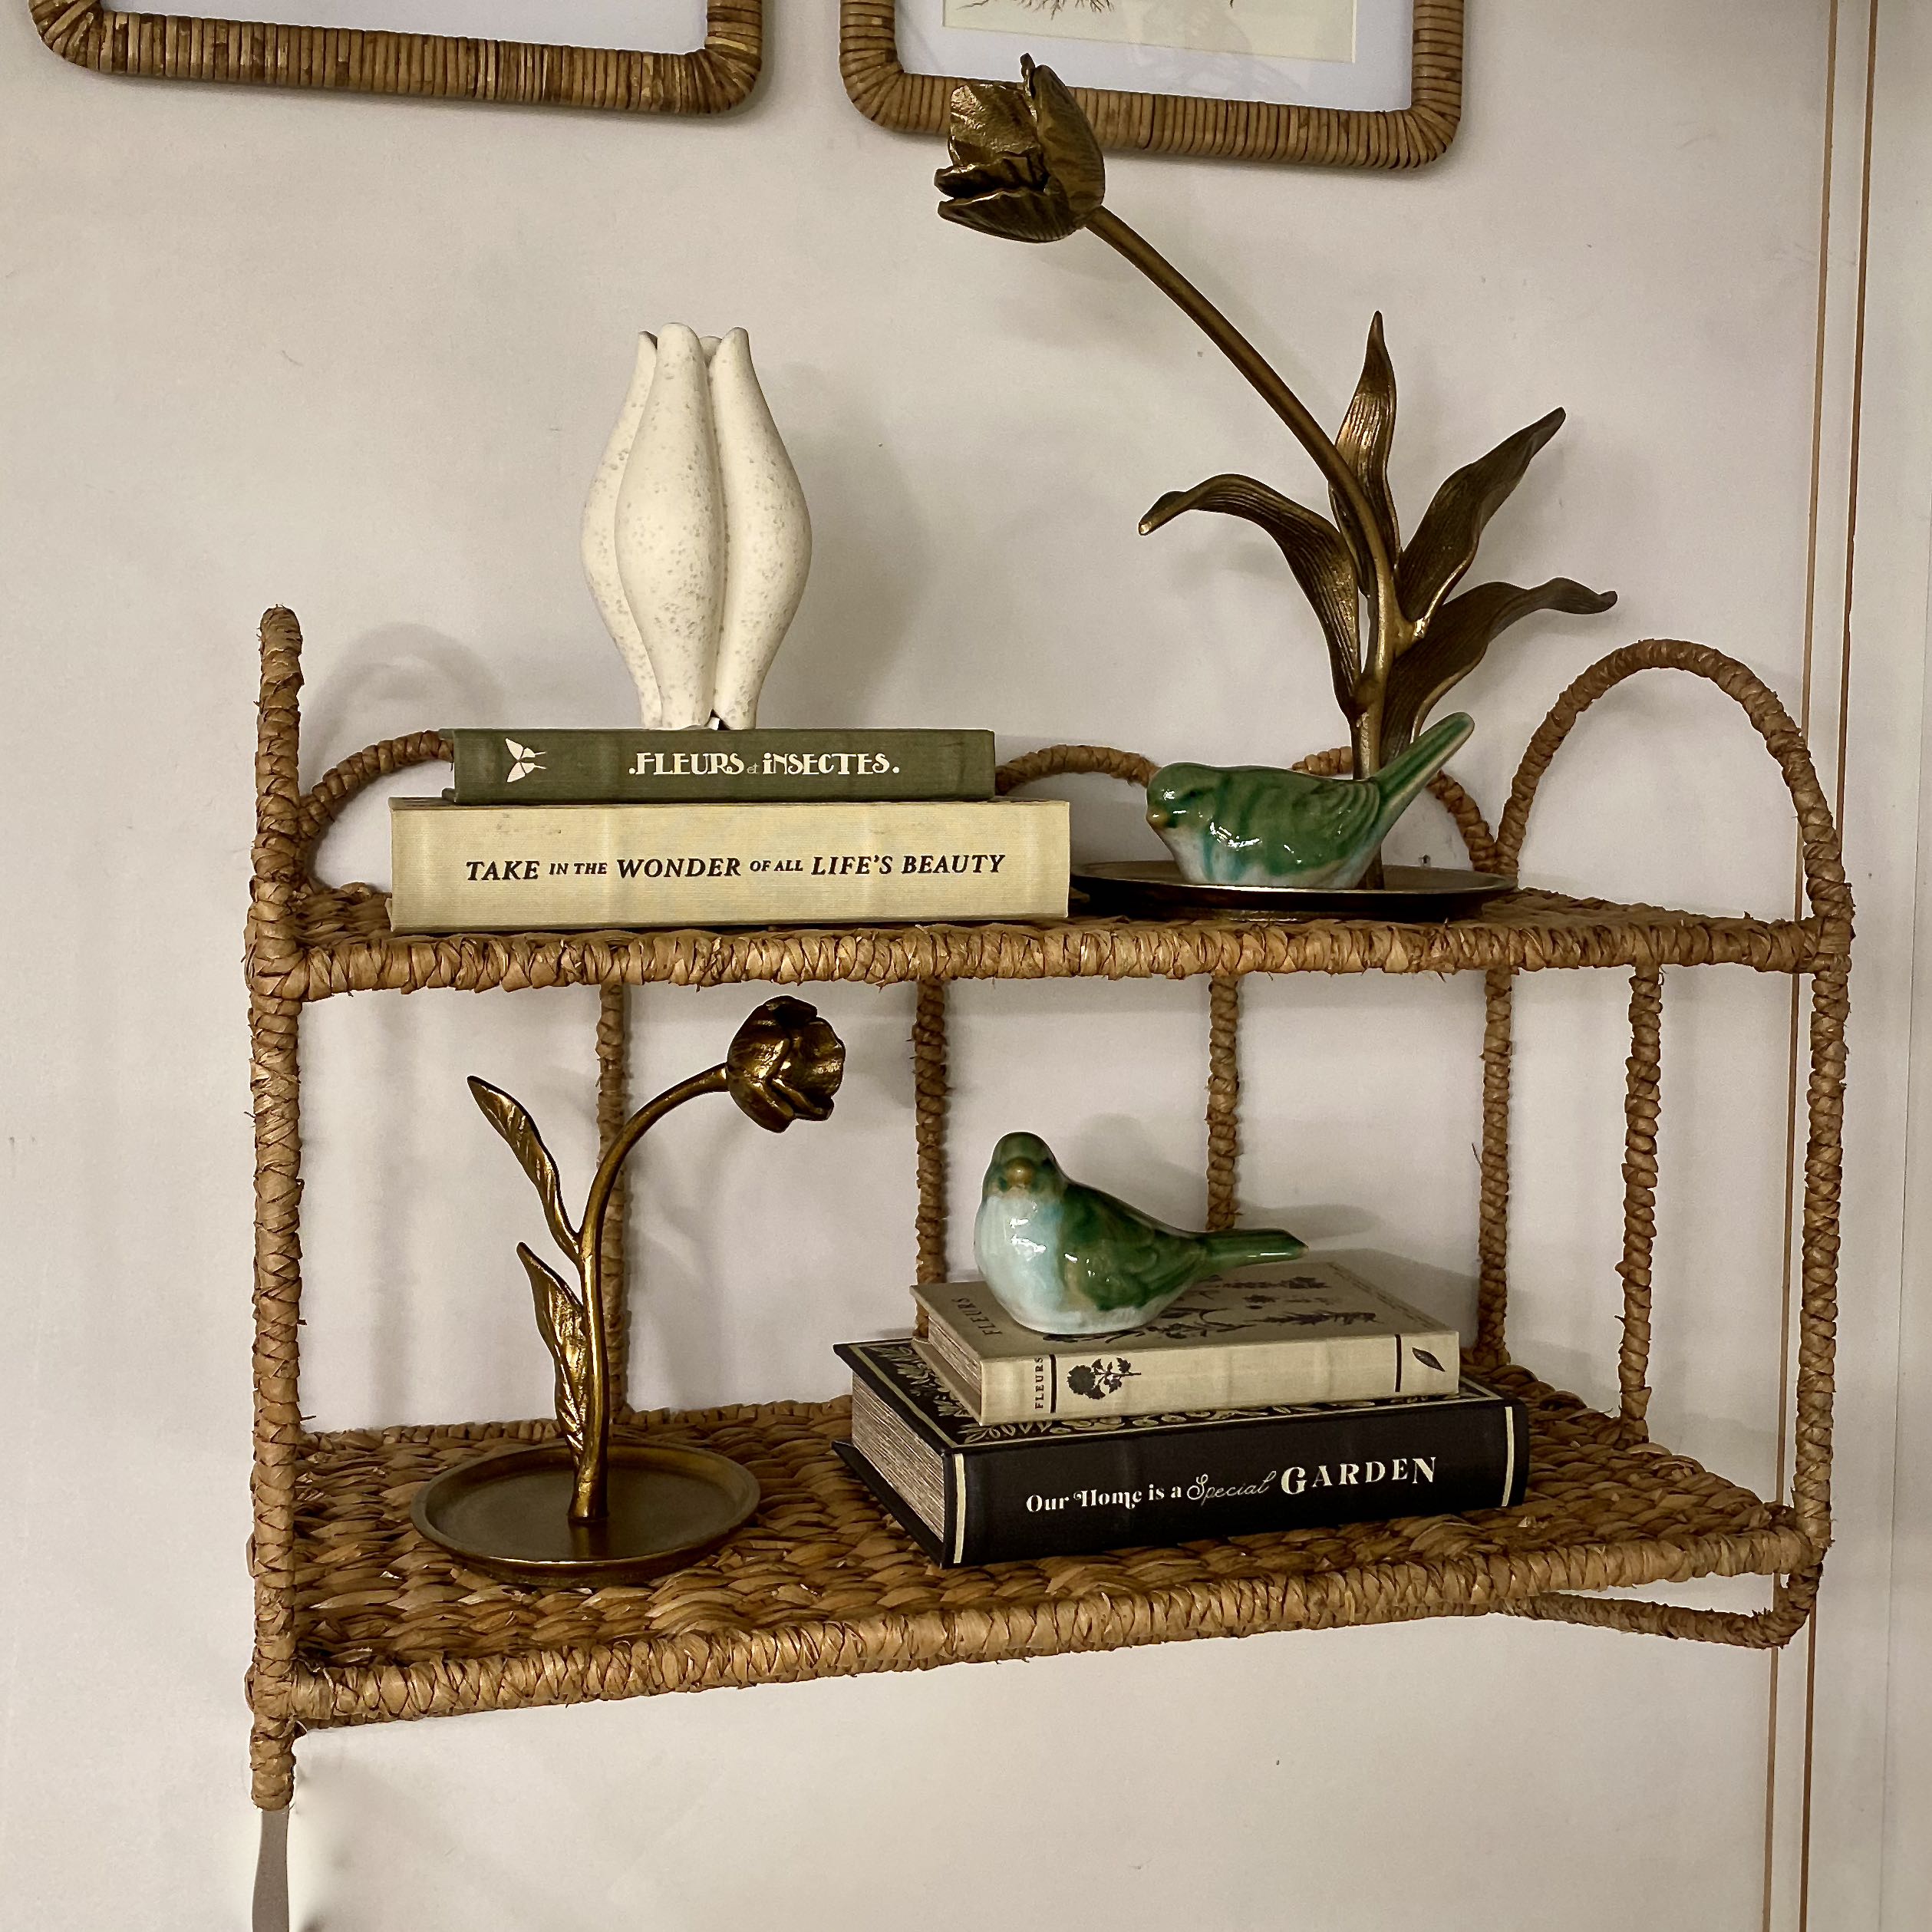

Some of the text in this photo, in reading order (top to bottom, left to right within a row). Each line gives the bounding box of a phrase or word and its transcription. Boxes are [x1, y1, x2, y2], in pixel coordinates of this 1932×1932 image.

[466, 860, 540, 881] TAKE
[549, 862, 568, 875] IN
[574, 862, 608, 875] THE
[616, 857, 741, 878] WONDER
[749, 860, 771, 872] OF
[773, 859, 803, 872] ALL
[901, 854, 1006, 874] BEAUTY
[951, 1297, 1003, 1335] FLEURS
[1034, 1357, 1045, 1409] FLEURS
[1026, 1456, 1436, 1513] Our Home is a Special GARDEN
